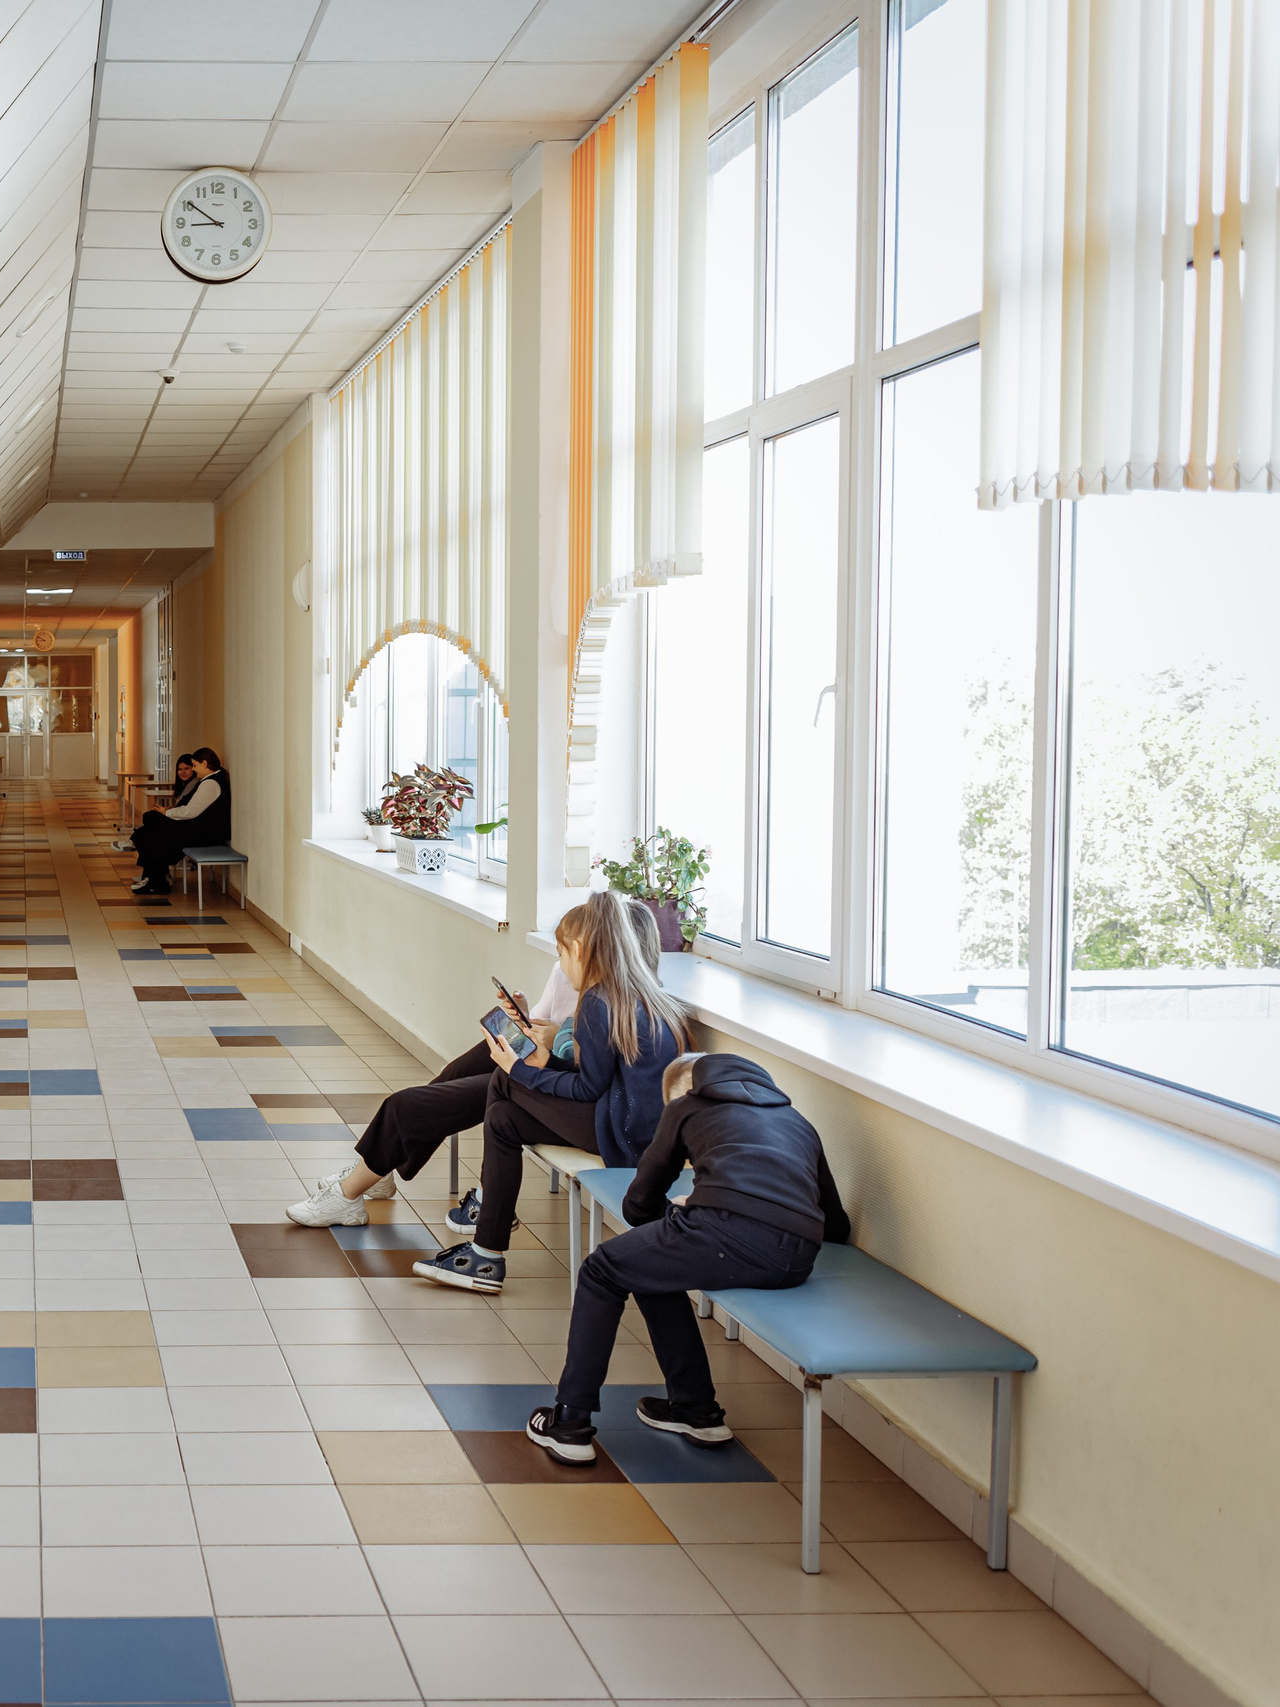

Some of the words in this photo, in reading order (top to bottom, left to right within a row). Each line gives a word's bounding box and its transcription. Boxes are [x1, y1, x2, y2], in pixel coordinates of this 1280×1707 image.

[196, 186, 207, 198] 11
[210, 182, 225, 194] 12
[233, 187, 238, 199] 1
[182, 200, 194, 212] 10
[243, 200, 253, 212] 2
[176, 217, 186, 229] 9
[248, 218, 258, 230] 3
[181, 235, 191, 247] 8
[242, 235, 252, 247] 4
[195, 248, 205, 260] 7
[211, 253, 221, 266] 6
[229, 249, 239, 261] 5
